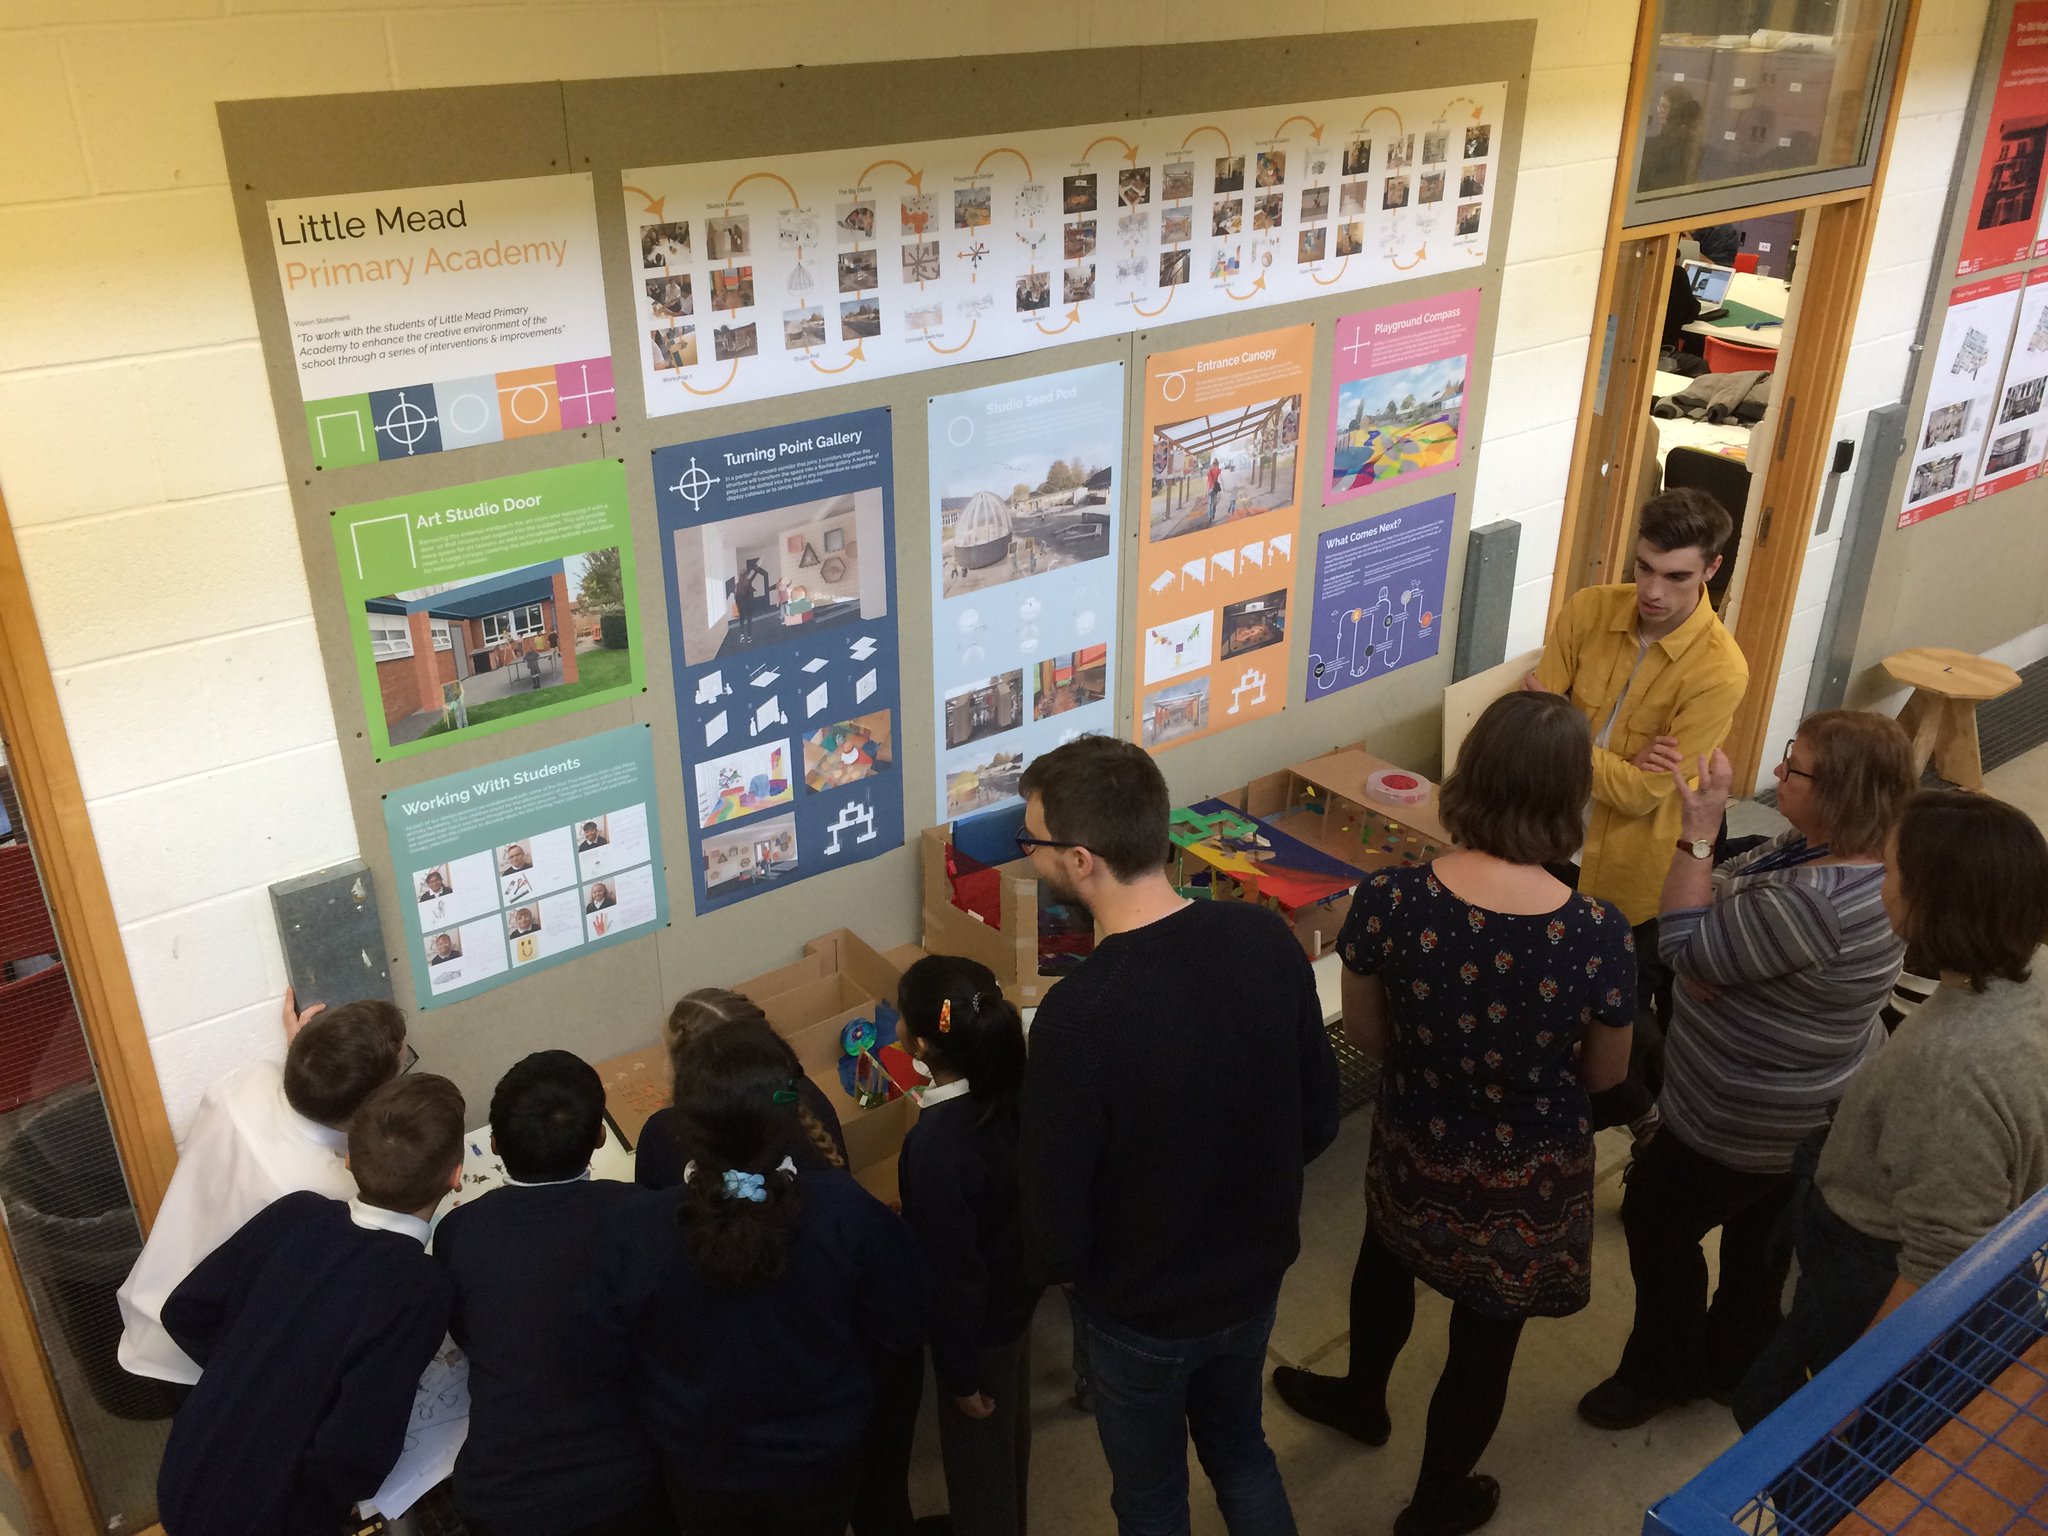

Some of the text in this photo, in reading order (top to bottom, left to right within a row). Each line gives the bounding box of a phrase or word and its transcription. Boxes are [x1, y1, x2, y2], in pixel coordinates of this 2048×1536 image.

[277, 200, 467, 245] Little Mead
[285, 240, 567, 290] Primary Academy
[294, 314, 350, 327] Vision Statement
[300, 315, 547, 357] Academy to enhance the creative environment of the
[315, 330, 340, 341] work
[342, 326, 363, 338] with
[366, 324, 381, 335] the
[384, 319, 425, 333] students
[427, 316, 438, 328] of
[440, 313, 462, 325] Little
[465, 309, 491, 321] Mead
[494, 306, 528, 319] Primary
[1374, 307, 1461, 335] Playground Compass
[302, 359, 336, 370] school
[338, 351, 376, 365] through
[379, 351, 386, 360] a
[388, 346, 416, 357] series
[418, 343, 429, 355] of
[430, 335, 489, 352] interventions
[490, 334, 498, 343] &
[1197, 348, 1277, 373] Entrance Canopy
[986, 385, 1077, 416] Studio Seed Pod
[724, 430, 863, 466] Turning Point Gallery
[416, 495, 542, 529] Art Studio Door
[1326, 518, 1402, 549] What Comes Next?
[402, 757, 581, 816] Working With Students
